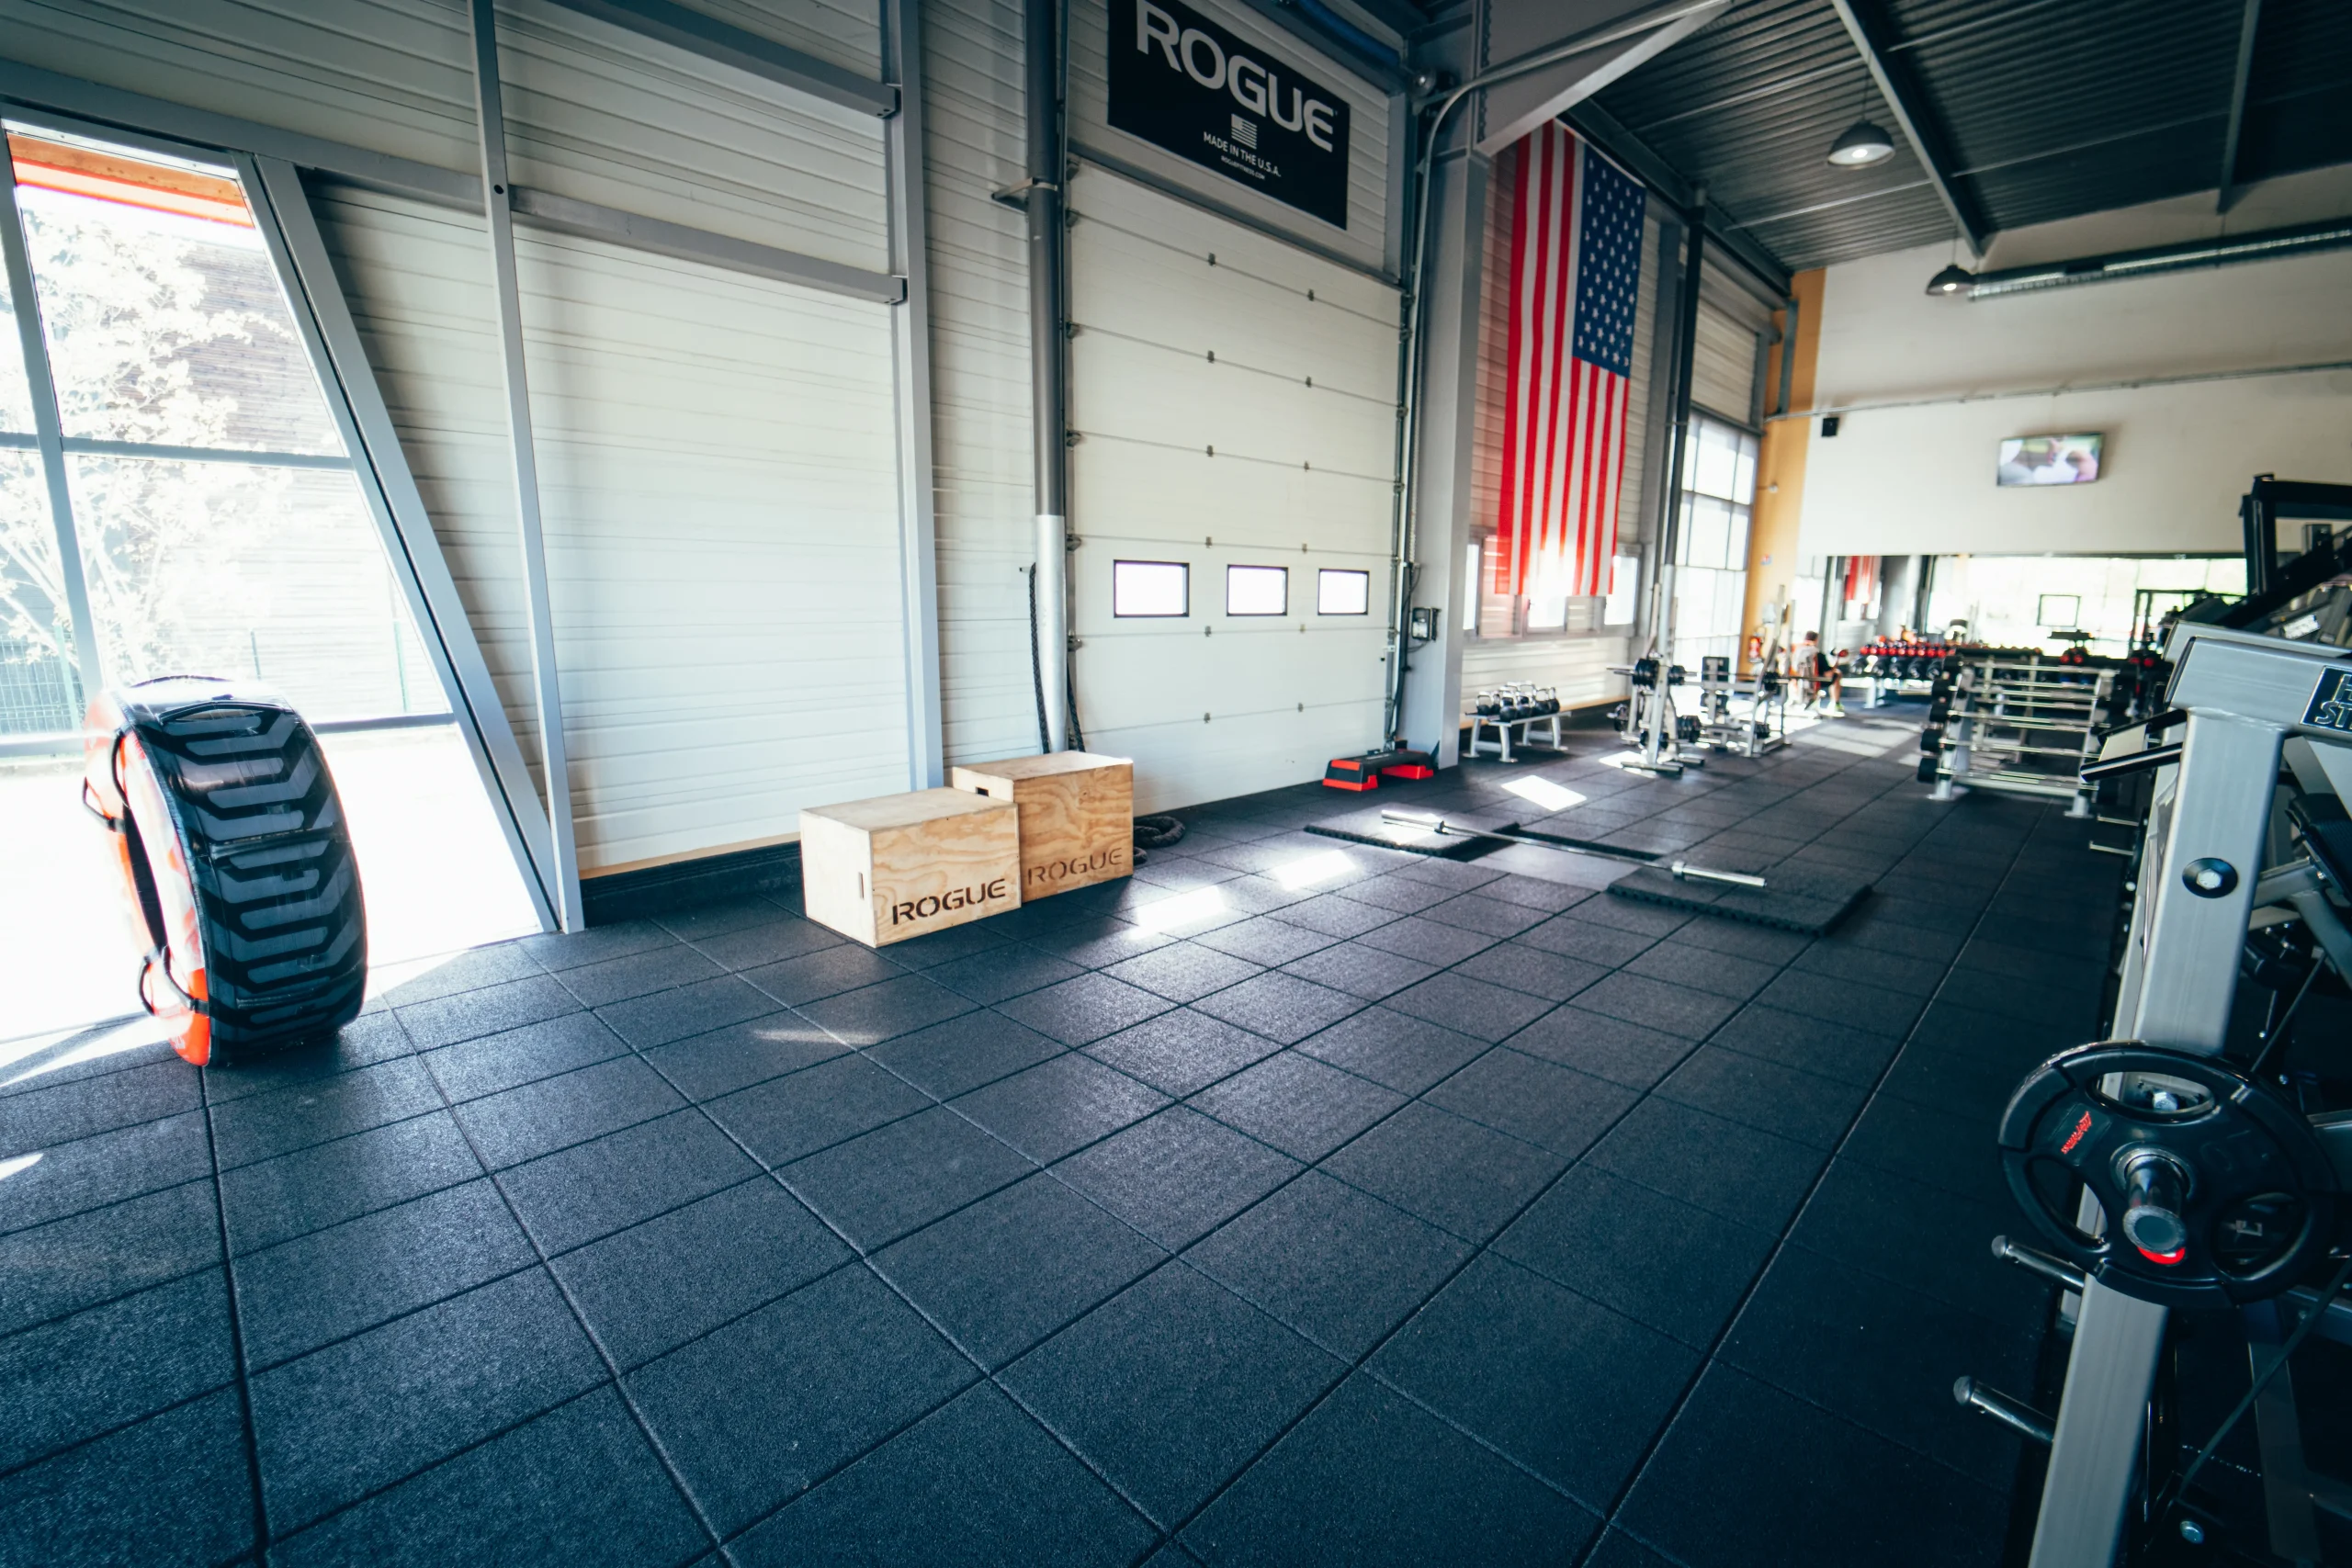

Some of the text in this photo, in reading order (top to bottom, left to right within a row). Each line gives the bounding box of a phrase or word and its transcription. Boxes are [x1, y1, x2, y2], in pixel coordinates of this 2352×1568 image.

[1136, 0, 1333, 152] ROGUE
[1203, 130, 1282, 177] MADE IN THE U.S.A.
[1027, 847, 1123, 886] ROGUE
[892, 878, 1005, 925] ROGUE
